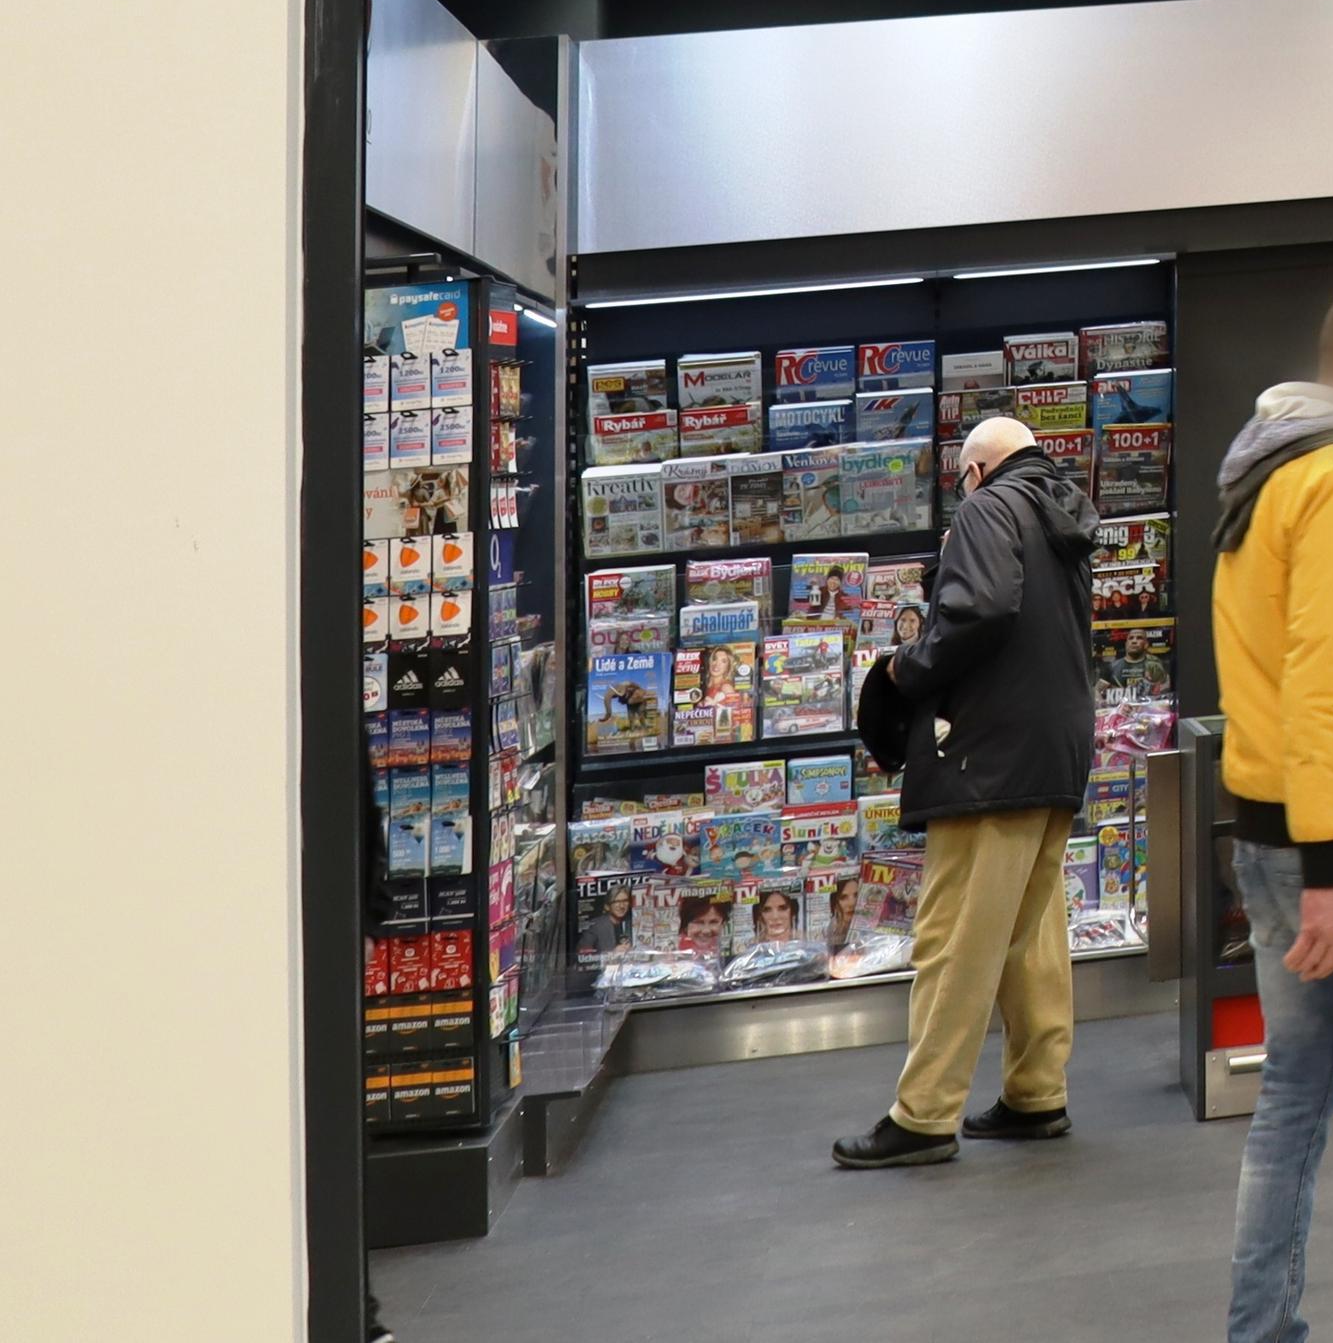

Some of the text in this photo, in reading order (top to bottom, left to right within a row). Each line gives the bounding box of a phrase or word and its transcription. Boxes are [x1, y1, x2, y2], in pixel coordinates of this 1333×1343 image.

[859, 345, 930, 375] RC revue
[1011, 343, 1067, 361] Válka
[776, 352, 848, 385] RC revue
[1018, 388, 1067, 404] CHIP
[684, 413, 727, 429] Rybář
[940, 408, 960, 422] TIP
[603, 417, 646, 432] Rybář
[1112, 432, 1158, 448] 100+1
[692, 610, 754, 635] chalupář
[596, 656, 654, 672] Lidé a Země
[872, 866, 897, 883] TV
[812, 876, 836, 893] TV
[655, 890, 682, 906] TV
[736, 886, 758, 904] TV
[392, 1021, 428, 1031] amazon
[434, 1017, 470, 1027] amazon
[394, 1088, 430, 1099] amazon
[435, 1085, 470, 1095] amazon
